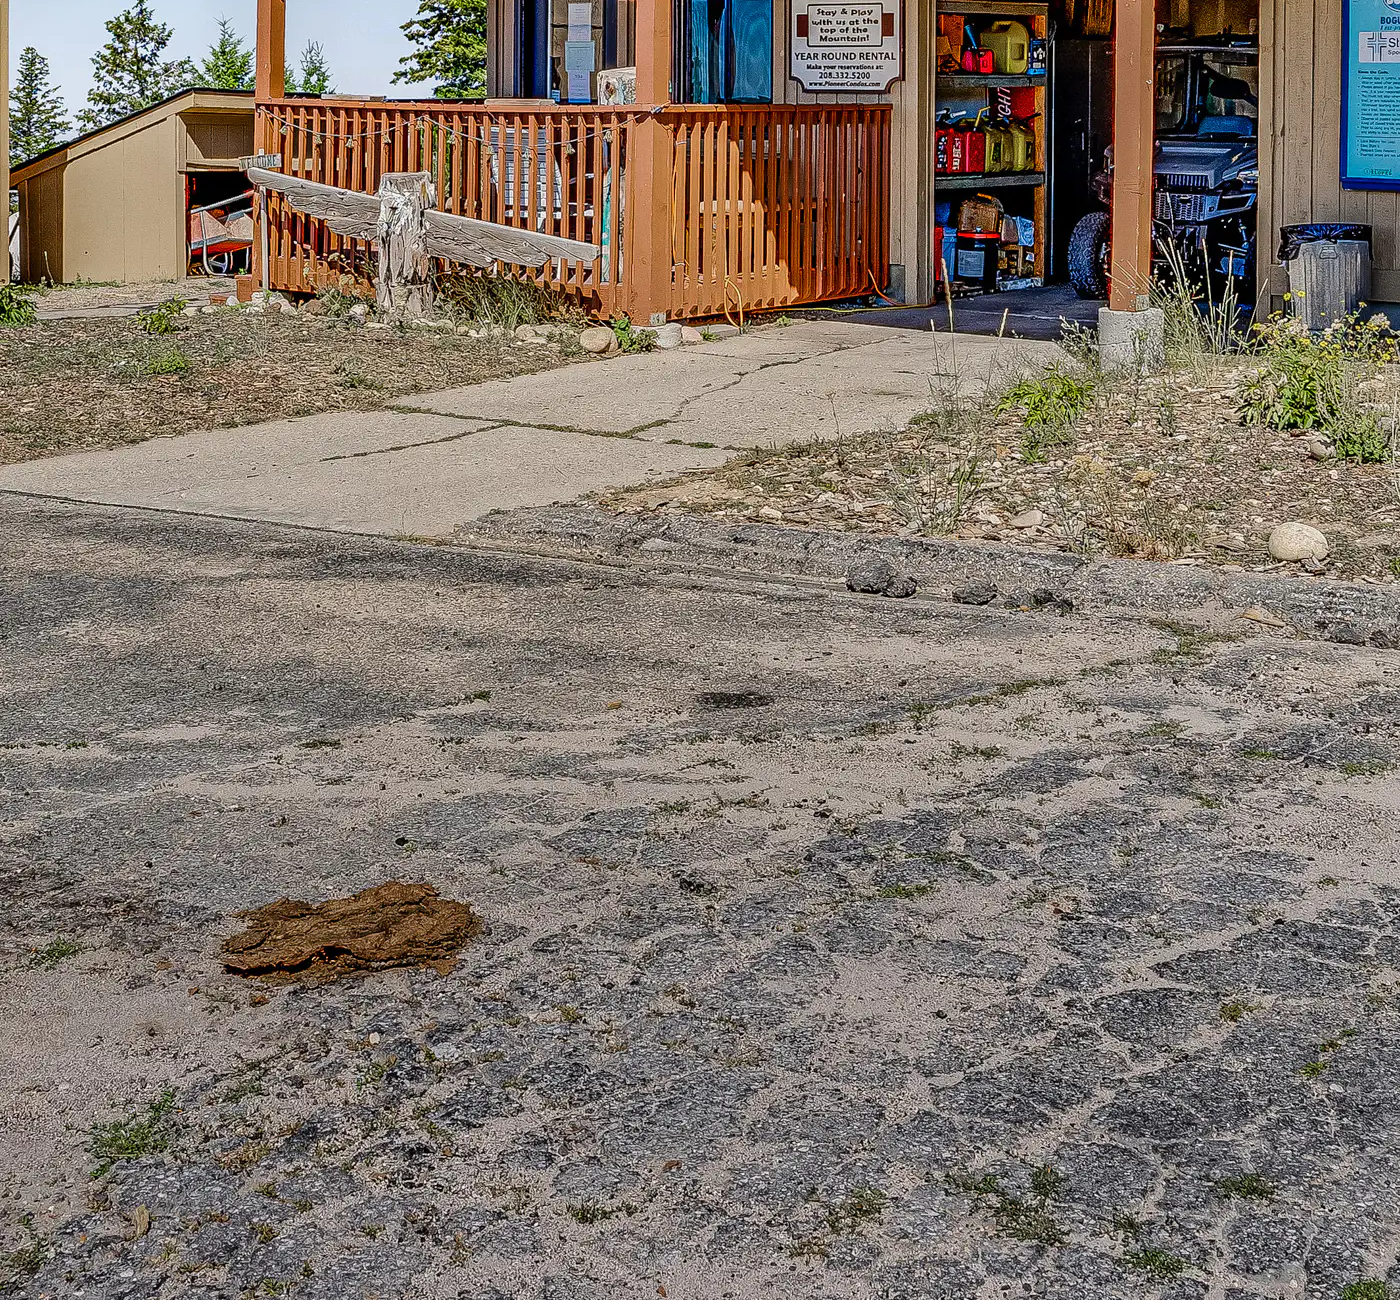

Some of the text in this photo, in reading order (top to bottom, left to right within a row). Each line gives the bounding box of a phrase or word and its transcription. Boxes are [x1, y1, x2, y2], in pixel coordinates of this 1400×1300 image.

[816, 8, 837, 17] Stay
[851, 8, 874, 16] Play
[811, 18, 833, 26] with
[848, 18, 860, 26] at
[861, 17, 879, 25] the
[820, 27, 837, 35] top
[819, 34, 870, 42] Mountain!
[794, 52, 897, 61] YEAR ROUND RENTAL
[818, 71, 871, 80] 208.332.5200
